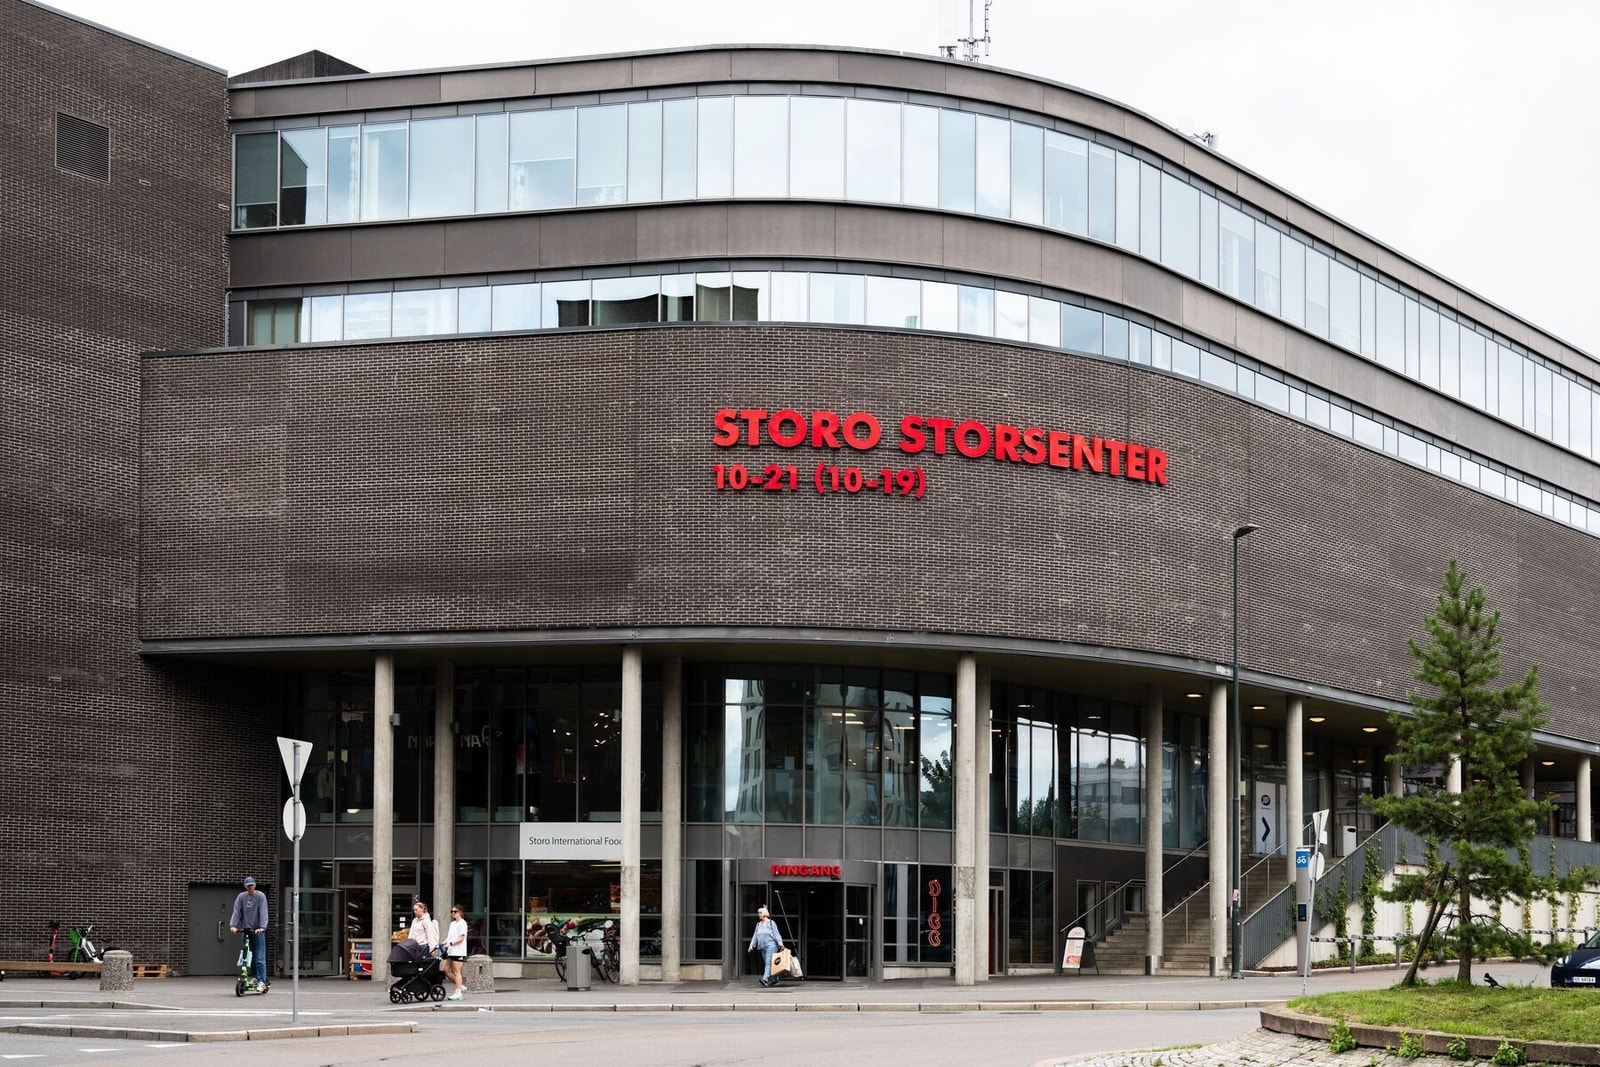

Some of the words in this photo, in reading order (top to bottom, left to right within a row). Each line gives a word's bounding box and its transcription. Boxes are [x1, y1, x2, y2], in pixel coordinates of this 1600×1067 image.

[712, 407, 882, 450] STORO
[899, 414, 1169, 486] STORSENTER
[713, 463, 798, 491] 10-21
[814, 461, 926, 499] (10-19)
[528, 836, 550, 846] Storo
[551, 836, 603, 846] International
[771, 864, 842, 877] INNGANG
